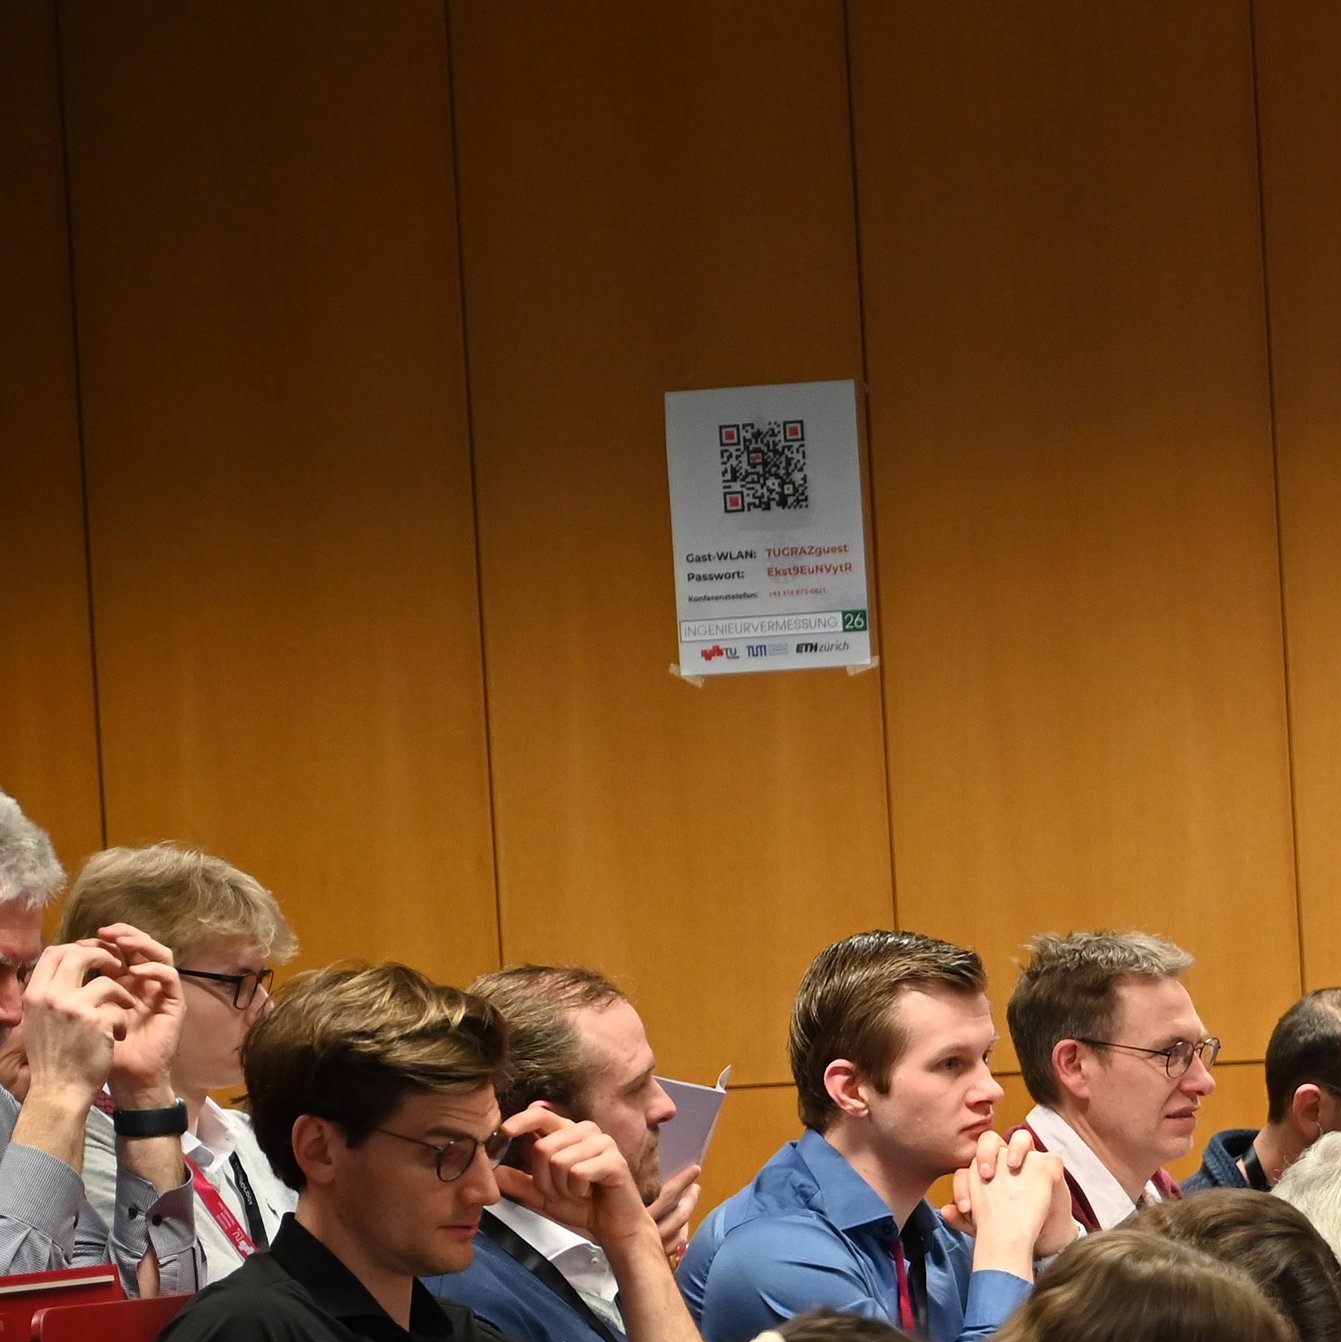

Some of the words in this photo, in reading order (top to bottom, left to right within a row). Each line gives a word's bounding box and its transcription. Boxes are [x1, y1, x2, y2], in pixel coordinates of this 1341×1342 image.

[686, 549, 757, 564] Gast-WLAN:
[766, 543, 848, 559] TUGRAZguest
[687, 570, 745, 583] Passwort:
[684, 615, 838, 637] INGENIEURVERMESSUNG
[844, 612, 864, 630] 26
[796, 640, 818, 653] ETH
[819, 640, 849, 653] zürich
